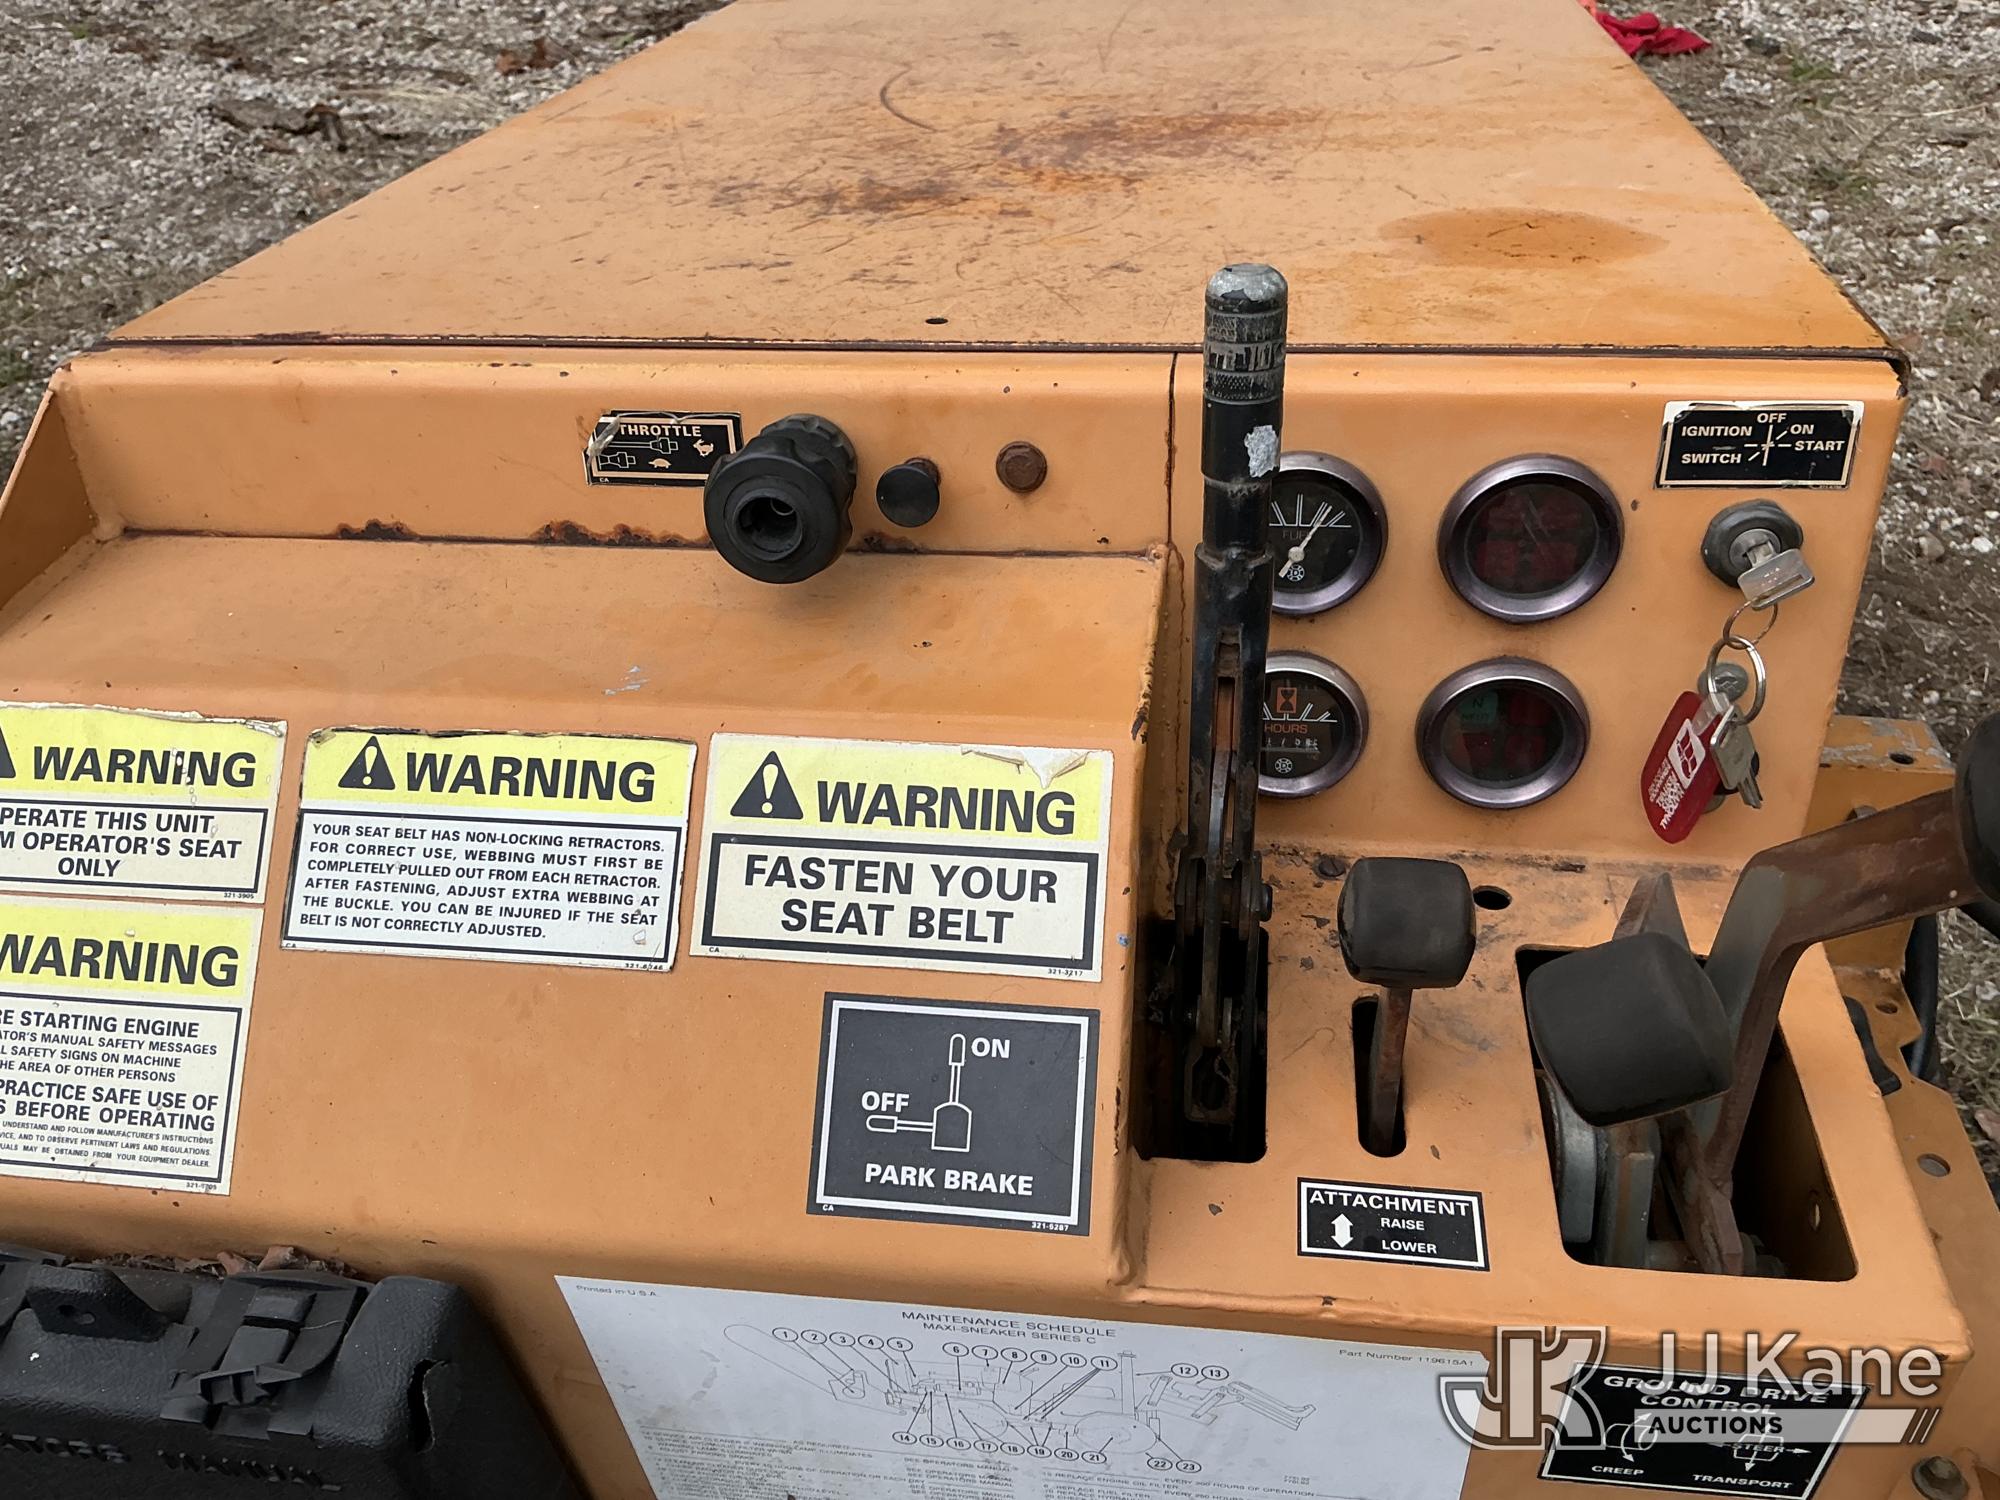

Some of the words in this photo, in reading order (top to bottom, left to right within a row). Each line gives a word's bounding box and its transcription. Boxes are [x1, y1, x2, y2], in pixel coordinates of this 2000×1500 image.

[1757, 413, 1787, 423] OFF
[620, 424, 702, 437] THROTTLE
[1682, 426, 1752, 436] IGNITION
[1790, 424, 1814, 434] ON
[1795, 440, 1845, 451] START
[1681, 453, 1742, 464] SWITCH
[1264, 723, 1308, 734] HOURS
[34, 746, 256, 788] WARNING
[407, 752, 655, 803] WARNING
[817, 780, 1075, 835] WARNING
[95, 811, 147, 831] THIS
[156, 813, 215, 833] UNIT
[23, 832, 170, 856] OPERATOR'S
[179, 838, 242, 858] SEAT
[313, 824, 351, 836] YOUR
[355, 826, 391, 838] SEAT
[395, 828, 427, 839] BELT
[431, 830, 460, 841] HAS
[465, 831, 563, 847] NON-LOCKING
[568, 836, 664, 852] RETRACTORS.
[58, 857, 121, 877] ONLY
[310, 842, 339, 853] FOR
[345, 843, 416, 857] CORRECT
[423, 847, 456, 861] USE,
[465, 849, 535, 863] WEBBING
[542, 853, 587, 866] MUST
[594, 856, 638, 869] FIRST
[644, 859, 663, 870] BE
[308, 859, 395, 874] COMPLETELY
[398, 864, 451, 877] PULLED
[455, 867, 485, 879] OUT
[488, 869, 528, 881] FROM
[532, 871, 570, 884] EACH
[574, 873, 660, 889] RETRACTOR.
[745, 854, 913, 895] FASTEN
[930, 864, 1057, 903] YOUR
[305, 877, 349, 890] AFTER
[355, 880, 440, 896] FASTENING,
[446, 885, 506, 898] ADJUST
[512, 888, 560, 902] EXTRA
[567, 891, 633, 906] WEBBING
[640, 896, 660, 907] AT
[303, 895, 329, 907] THE
[335, 897, 393, 911] BUCKLE.
[401, 901, 431, 913] YOU
[438, 903, 469, 915] CAN
[475, 905, 493, 916] BE
[499, 906, 561, 920] INJURED
[568, 910, 581, 921] IF
[587, 911, 614, 923] THE
[620, 912, 658, 926] SEAT
[781, 899, 895, 936] SEAT
[908, 906, 1014, 944] BELT
[300, 913, 332, 926] BELT
[335, 915, 347, 927] IS
[351, 916, 381, 928] NOT
[384, 918, 464, 933] CORRECTLY
[467, 923, 546, 938] ADJUSTED.
[0, 934, 238, 987] WARNING
[1049, 969, 1083, 977] 321-3217
[20, 1011, 117, 1032] STARTING
[124, 1018, 199, 1038] ENGINE
[41, 1033, 94, 1046] MANUAL
[98, 1037, 145, 1050] SAFETY
[148, 1041, 217, 1055] MESSAGES
[971, 1037, 1010, 1058] ON
[11, 1045, 57, 1058] SAFETY
[60, 1049, 97, 1062] SIGNS
[101, 1052, 120, 1063] ON
[123, 1054, 181, 1068] MACHINE
[18, 1061, 51, 1073] AREA
[55, 1064, 71, 1074] OF
[74, 1065, 114, 1078] OTHER
[118, 1069, 175, 1083] PERSONS
[92, 1086, 142, 1105] SAFE
[148, 1091, 187, 1108] USE
[192, 1094, 219, 1111] OF
[862, 1091, 909, 1112] OFF
[15, 1100, 91, 1121] BEFORE
[99, 1107, 215, 1132] OPERATING
[2, 1121, 49, 1131] UNDERSTAND
[67, 1126, 95, 1135] FOLLOW
[96, 1129, 160, 1140] MANUFACTURER'S
[162, 1134, 213, 1144] INSTRUCTIONS
[18, 1133, 33, 1141] AND
[36, 1134, 45, 1142] TO
[47, 1135, 78, 1145] OBSERVE
[80, 1138, 119, 1148] PERTINENT
[121, 1142, 140, 1150] LAWS
[160, 1145, 210, 1156] REGULATIONS.
[41, 1146, 50, 1154] BE
[54, 1148, 89, 1157] OBTAINED
[92, 1151, 112, 1159] FROM
[117, 1153, 136, 1161] YOUR
[138, 1155, 180, 1165] EQUIPMENT
[181, 1159, 209, 1167] DEALER.
[865, 1163, 935, 1188] PARK
[944, 1169, 1033, 1196] BRAKE
[1310, 1190, 1469, 1216] ATTACHMENT
[1381, 1217, 1425, 1231] RAISE
[1382, 1240, 1437, 1254] LOWER
[901, 1311, 1020, 1330] MAINTENANCE
[1026, 1322, 1116, 1337] SCHEDULE
[923, 1322, 1026, 1338] MAXI-SNEAKER
[1031, 1332, 1081, 1342] SERIES
[1086, 1336, 1096, 1344] C
[1339, 1349, 1362, 1357] Part
[1366, 1352, 1412, 1361] Number
[1640, 1395, 1777, 1415] CONTROL
[1740, 1387, 1828, 1403] DRIVE
[1591, 1465, 1644, 1476] CREEP
[1692, 1474, 1792, 1489] TRANSPORT
